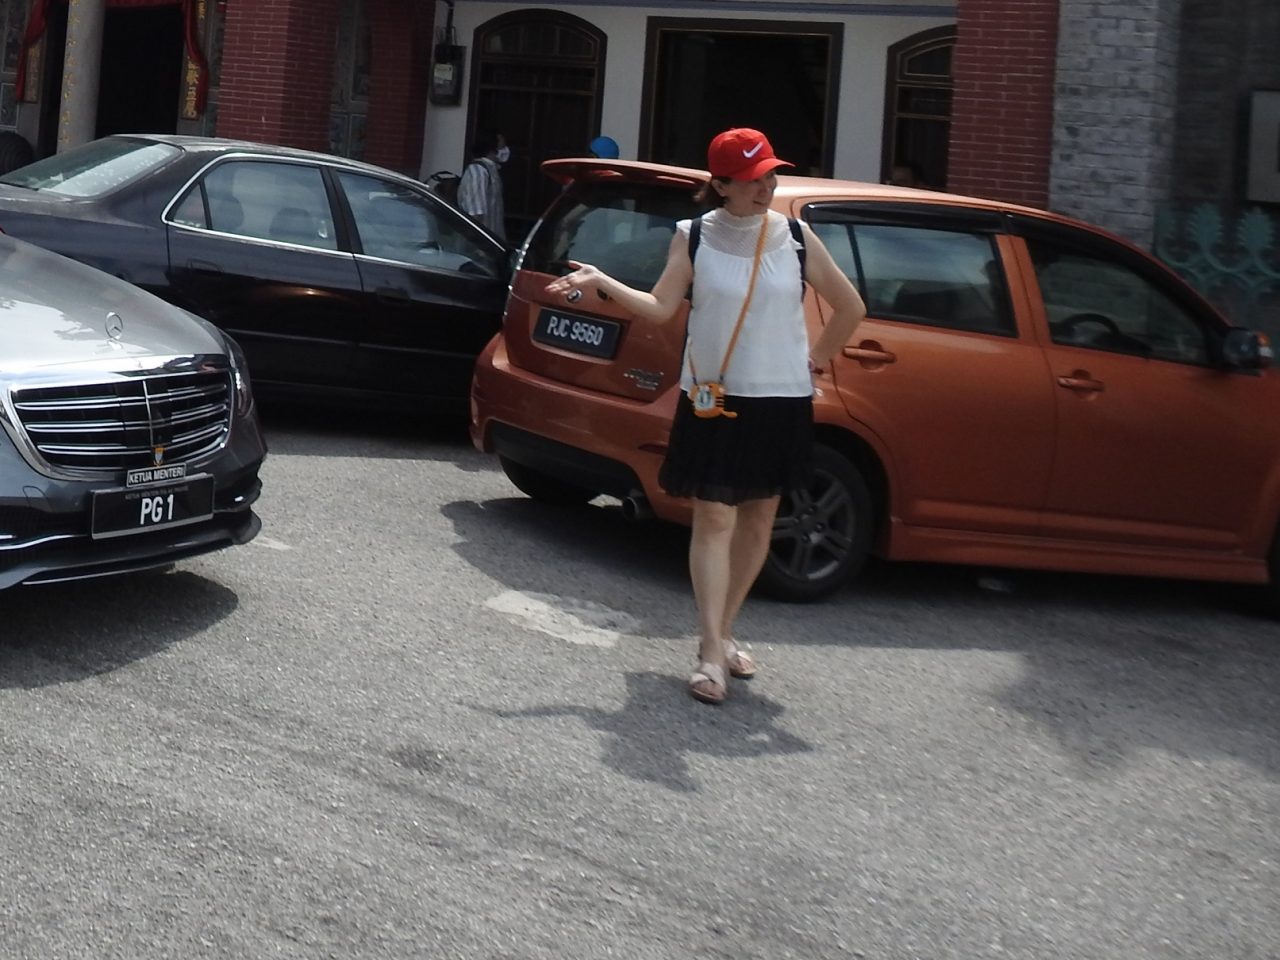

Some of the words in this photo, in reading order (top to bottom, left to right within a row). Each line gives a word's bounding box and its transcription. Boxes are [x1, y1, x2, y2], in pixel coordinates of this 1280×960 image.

[546, 315, 570, 337] PJC
[570, 321, 605, 345] 9560
[129, 471, 152, 484] KETUA
[153, 466, 184, 480] MENTERI
[140, 496, 163, 525] PG
[167, 494, 174, 520] 1
